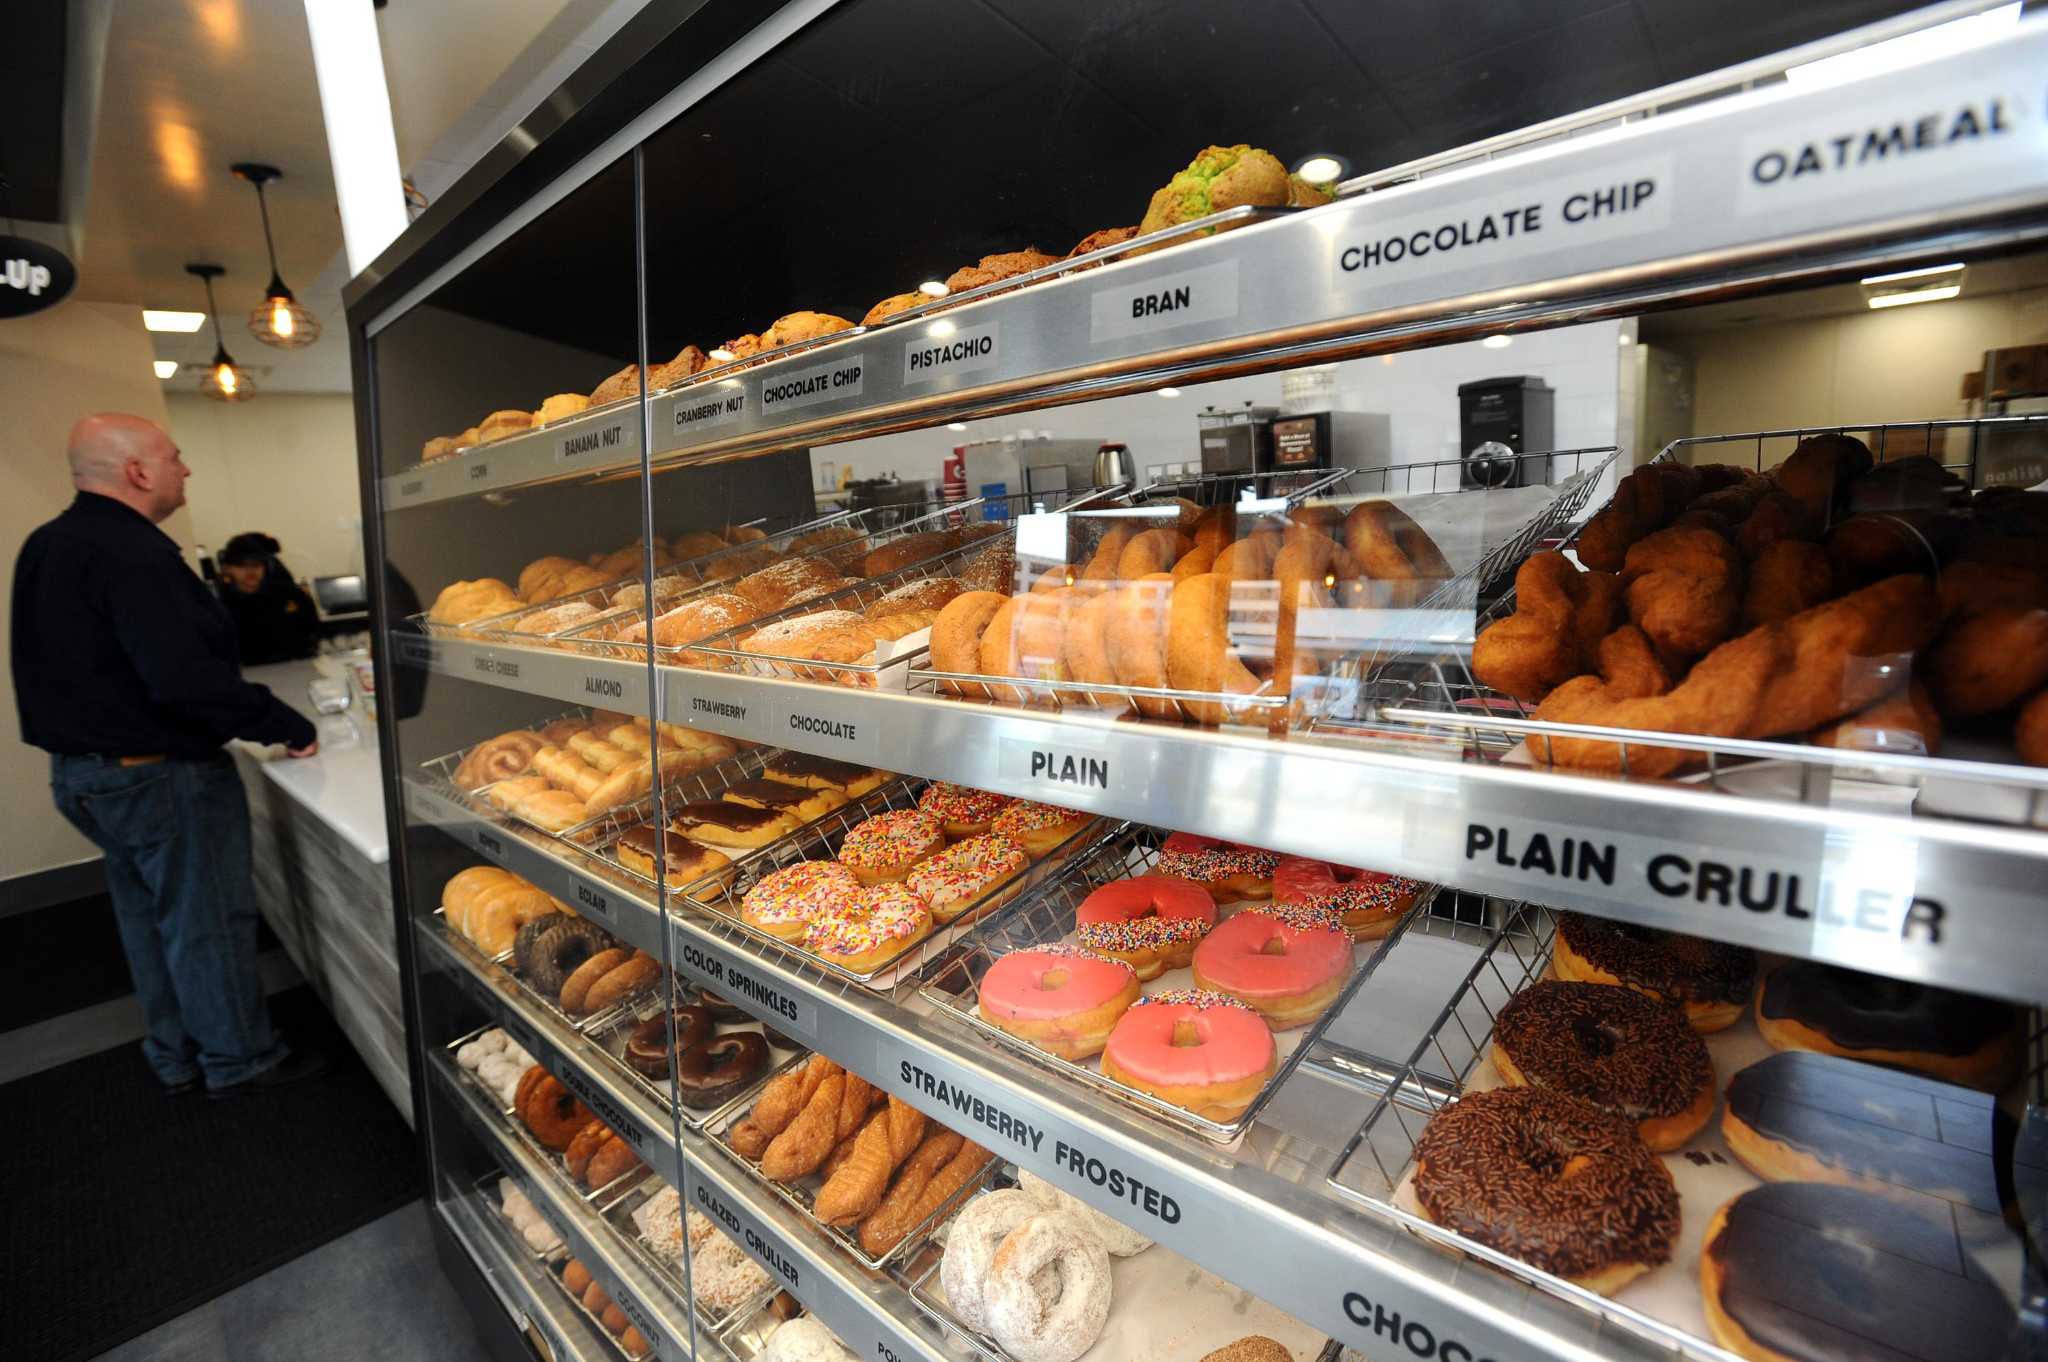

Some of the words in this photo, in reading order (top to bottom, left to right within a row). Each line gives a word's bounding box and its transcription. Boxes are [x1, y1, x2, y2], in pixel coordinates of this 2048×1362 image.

[1753, 98, 2011, 184] OATMEAL
[1340, 204, 1543, 273] CHOCOLATE
[1562, 178, 1657, 223] CHIP
[1132, 285, 1190, 318] BRAN
[910, 336, 993, 370] PISTACHIO
[763, 374, 828, 404] CHOCOLATE
[833, 366, 862, 388] CHIP
[676, 400, 723, 425] CRANBERRY
[726, 396, 745, 411] NUT
[565, 432, 599, 456] BANANA
[603, 426, 621, 447] NUT
[585, 677, 622, 697] ALMOND
[692, 697, 747, 720] STRAWBERRY
[789, 714, 856, 740] CHOCOLATE
[1031, 751, 1108, 789] PLAIN
[578, 884, 608, 915] ECLAIR
[1465, 823, 1617, 885] PLAIN
[1646, 853, 1946, 944] CRULLER
[683, 945, 723, 981] COLOR
[728, 968, 798, 1021] SPRINKLES
[592, 1093, 643, 1148] CHOCOLATE
[900, 1060, 1044, 1152] STRAWBERRY
[1056, 1140, 1181, 1225] FROSTED
[697, 1185, 740, 1234] GLAZED
[745, 1228, 799, 1287] CRULLER
[617, 1291, 660, 1347] COCONUT
[1342, 1291, 1495, 1362] CHOC
